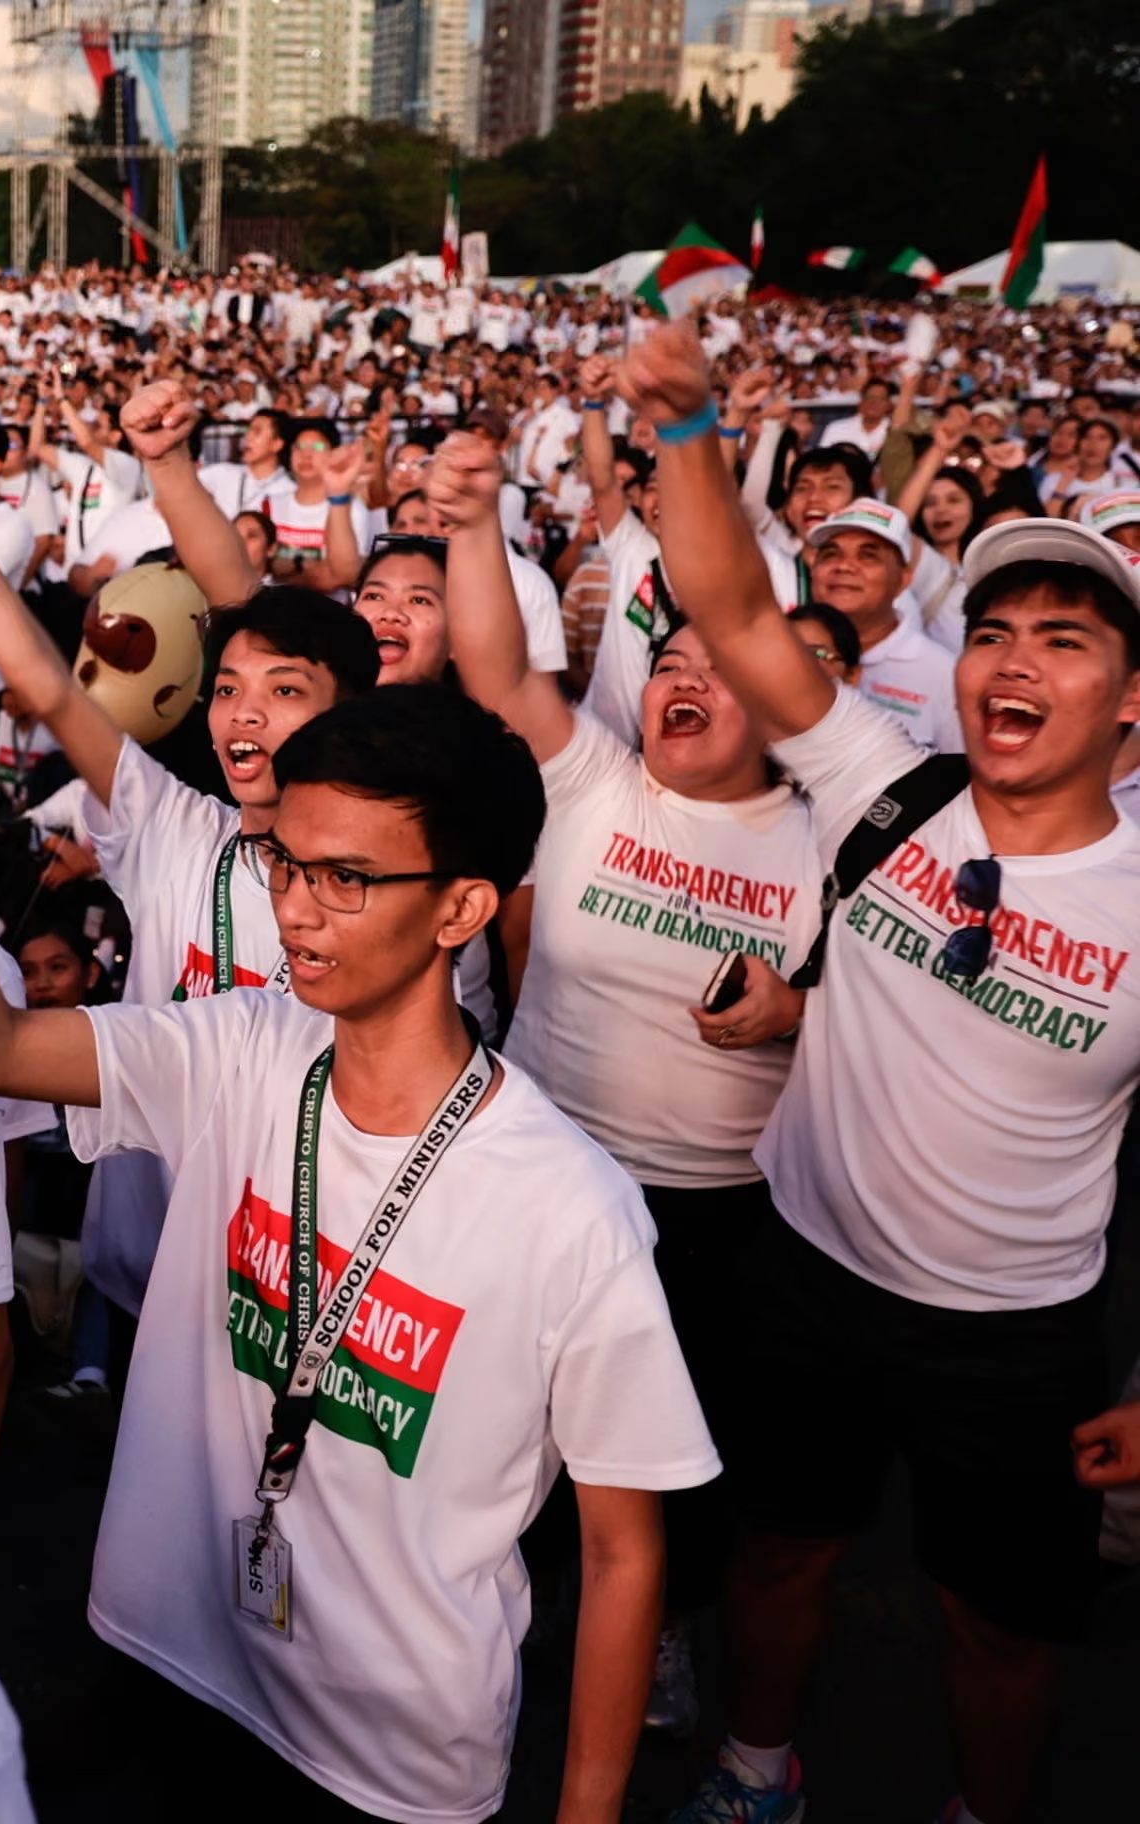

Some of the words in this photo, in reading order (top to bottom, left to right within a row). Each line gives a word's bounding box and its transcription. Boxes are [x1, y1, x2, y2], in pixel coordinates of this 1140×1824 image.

[578, 884, 652, 930] BETTER
[601, 832, 797, 922] TRANSPARENCY
[667, 892, 691, 912] FOR
[845, 893, 931, 969] BETTER
[310, 1065, 323, 1082] NI
[301, 1087, 317, 1156] CRISTO
[298, 1160, 311, 1246] (CHURCH
[315, 1257, 372, 1348] SCHOOL
[365, 1202, 403, 1254] FOR
[395, 1073, 483, 1199] MINISTERS
[298, 1251, 311, 1277] OF
